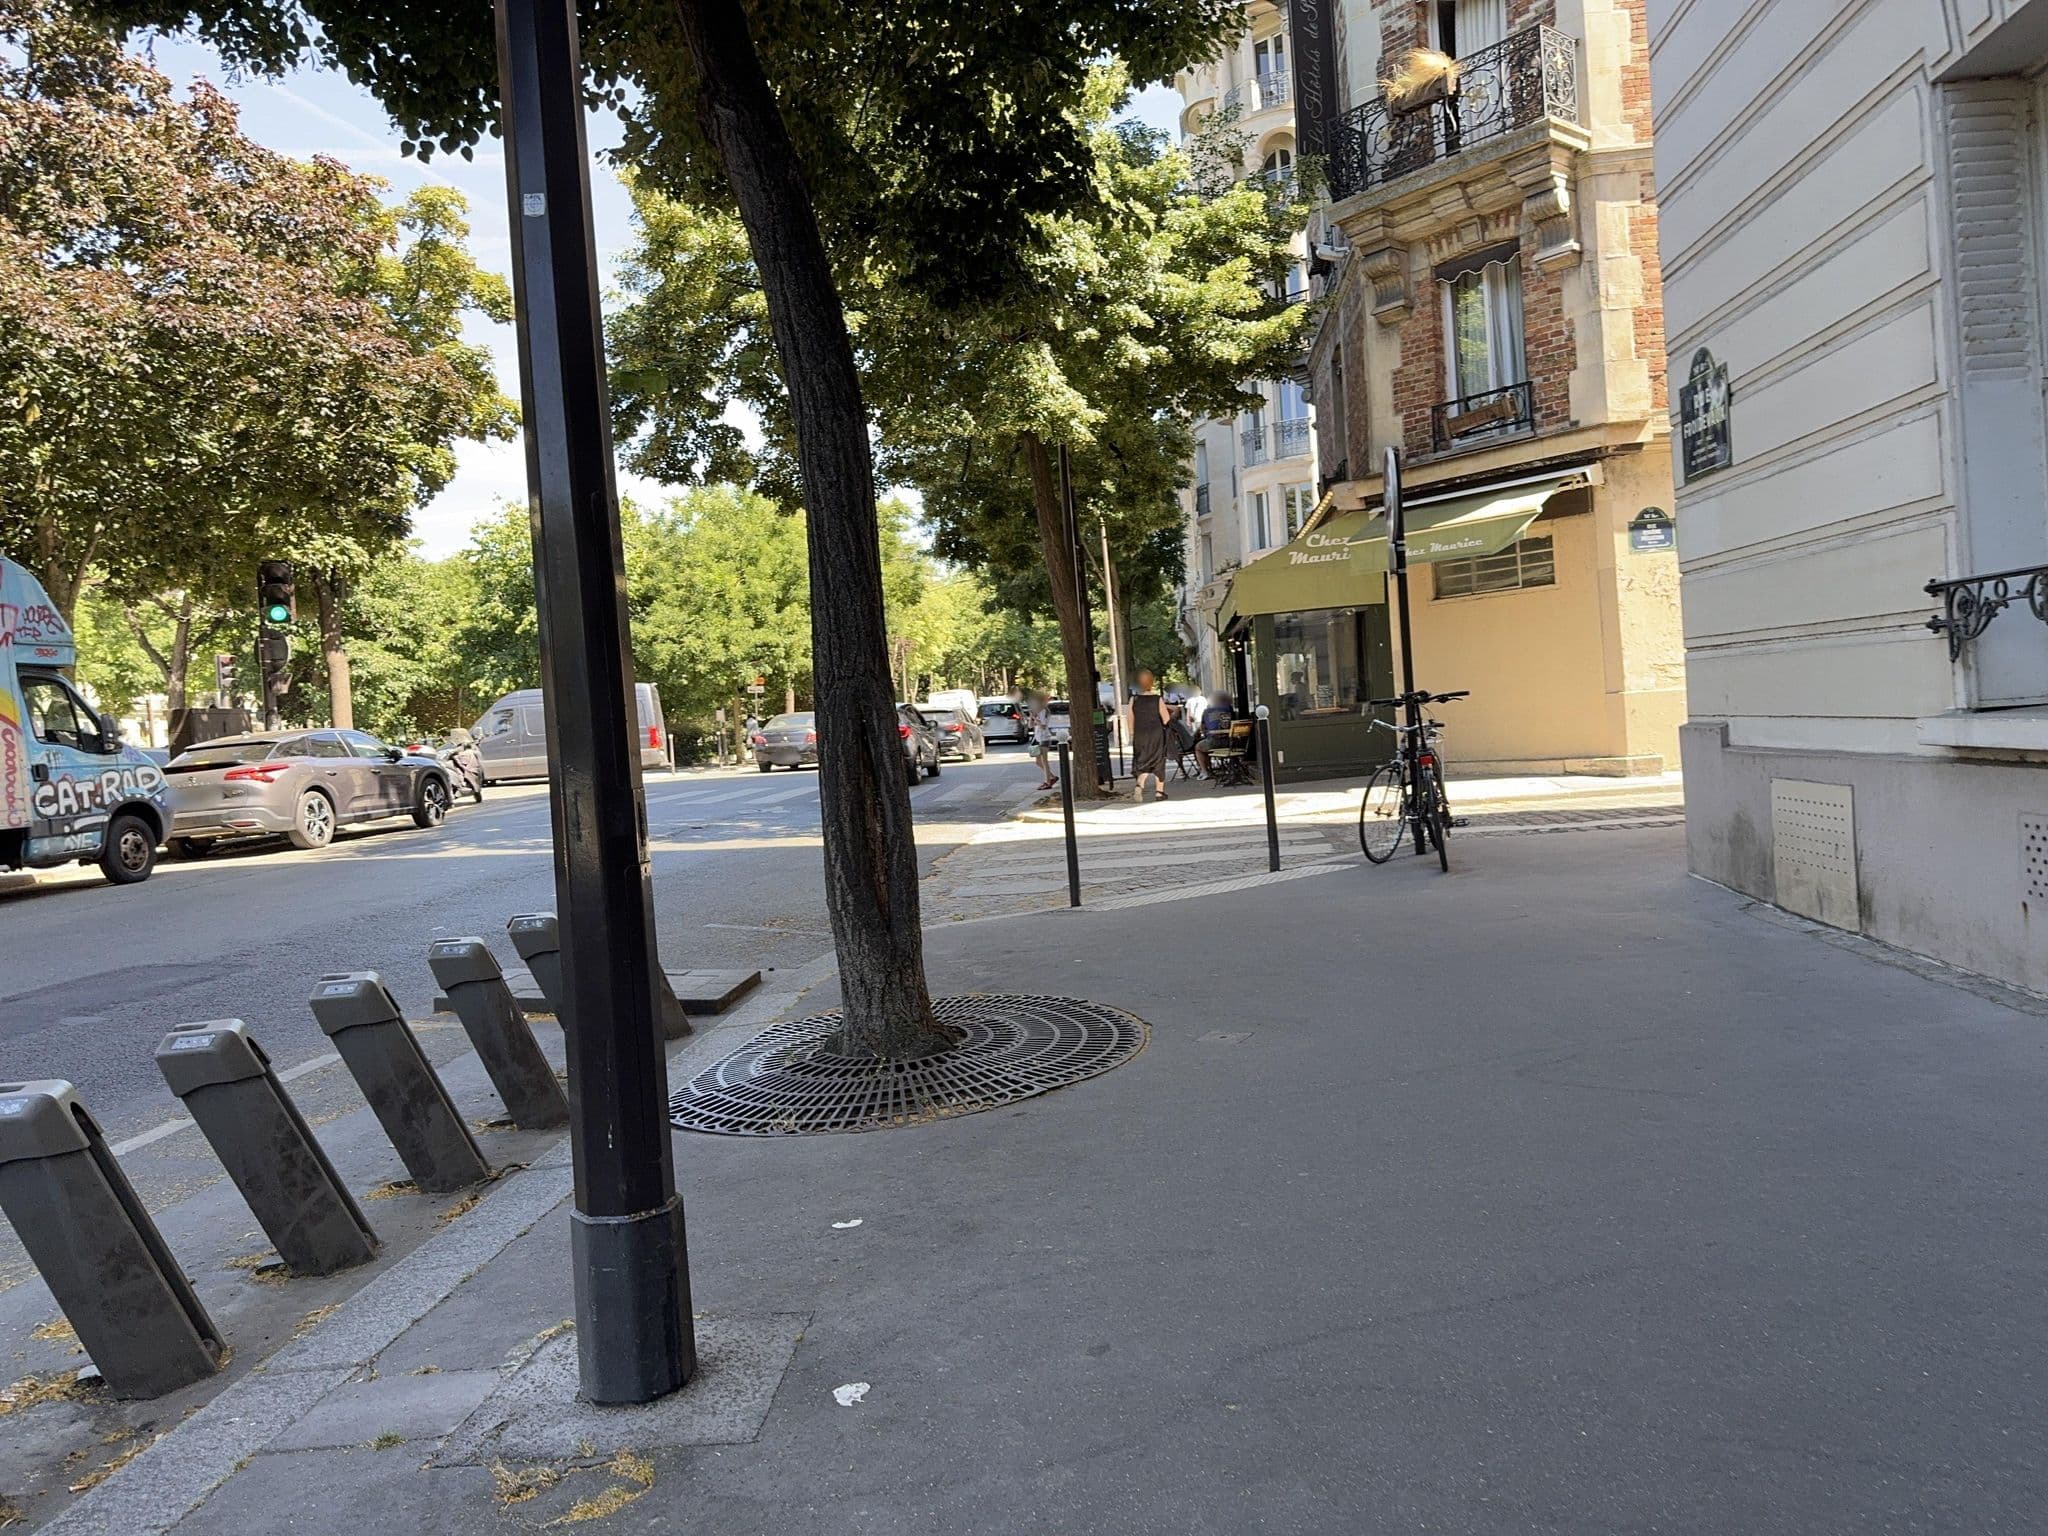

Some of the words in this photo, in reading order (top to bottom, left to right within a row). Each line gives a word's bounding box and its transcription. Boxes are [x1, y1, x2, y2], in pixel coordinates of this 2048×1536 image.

[1303, 22, 1319, 39] de
[1306, 533, 1351, 547] Chez
[1405, 548, 1425, 557] hez
[1430, 538, 1484, 553] Maurice
[1288, 547, 1352, 565] Mauri
